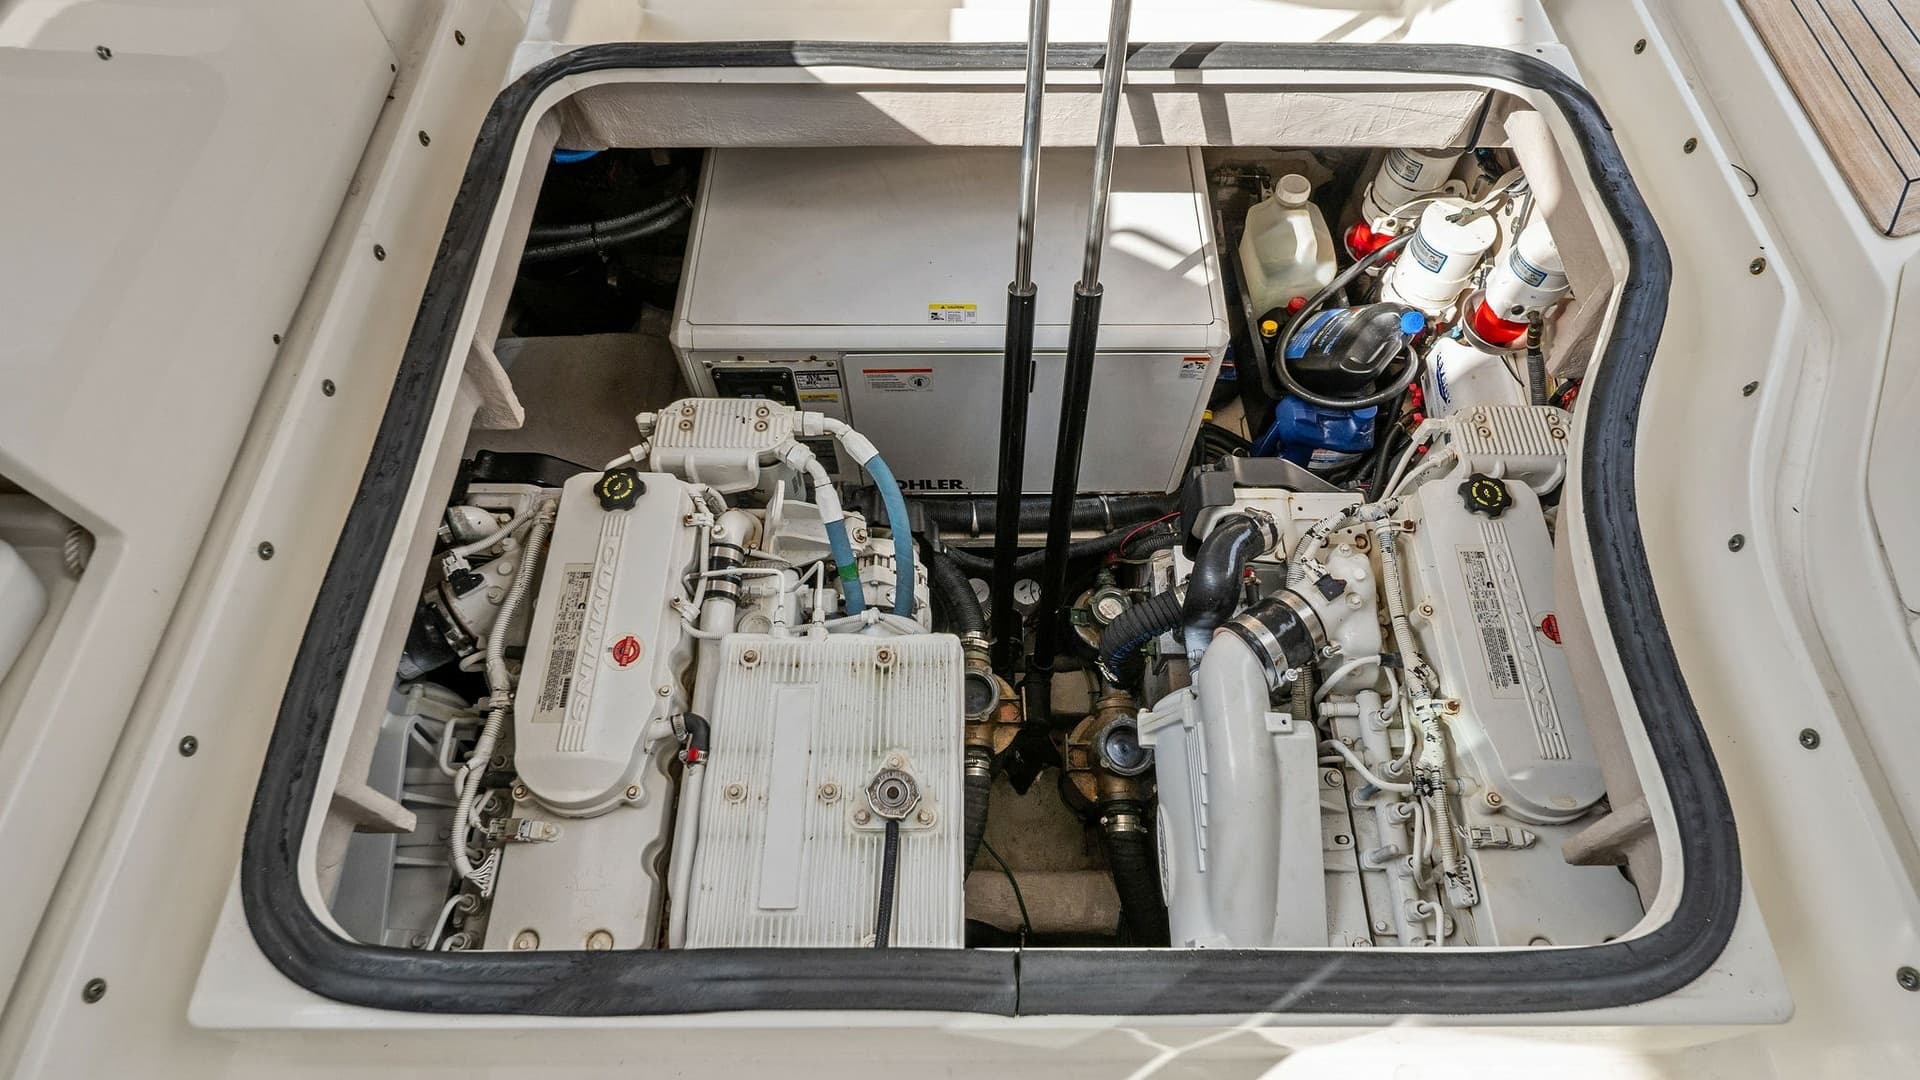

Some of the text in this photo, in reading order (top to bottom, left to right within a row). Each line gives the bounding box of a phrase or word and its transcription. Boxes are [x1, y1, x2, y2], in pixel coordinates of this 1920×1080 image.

[896, 479, 966, 490] OHLER
[571, 545, 615, 723] CUMMINS
[1493, 550, 1556, 730] CUMMINS
